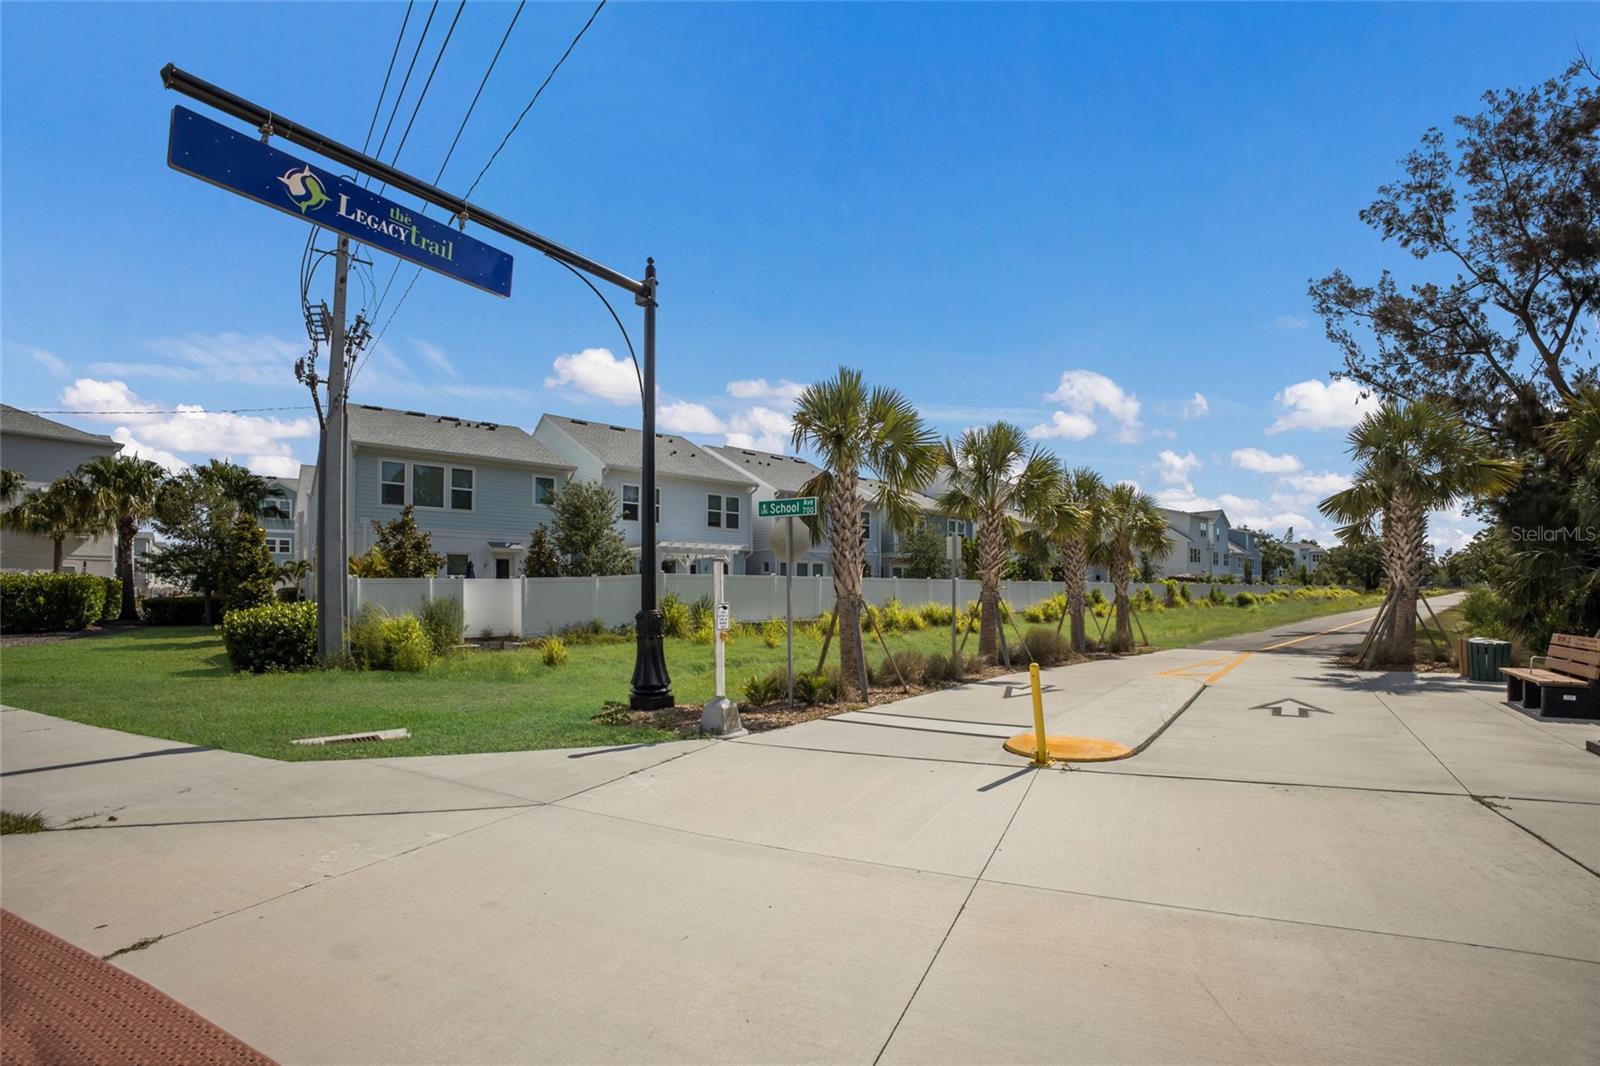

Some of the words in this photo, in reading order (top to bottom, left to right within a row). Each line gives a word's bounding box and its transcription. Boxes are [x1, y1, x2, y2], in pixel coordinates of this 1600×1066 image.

[390, 207, 412, 225] the
[337, 193, 409, 241] LEGACY
[410, 226, 453, 261] trail
[770, 501, 800, 514] School
